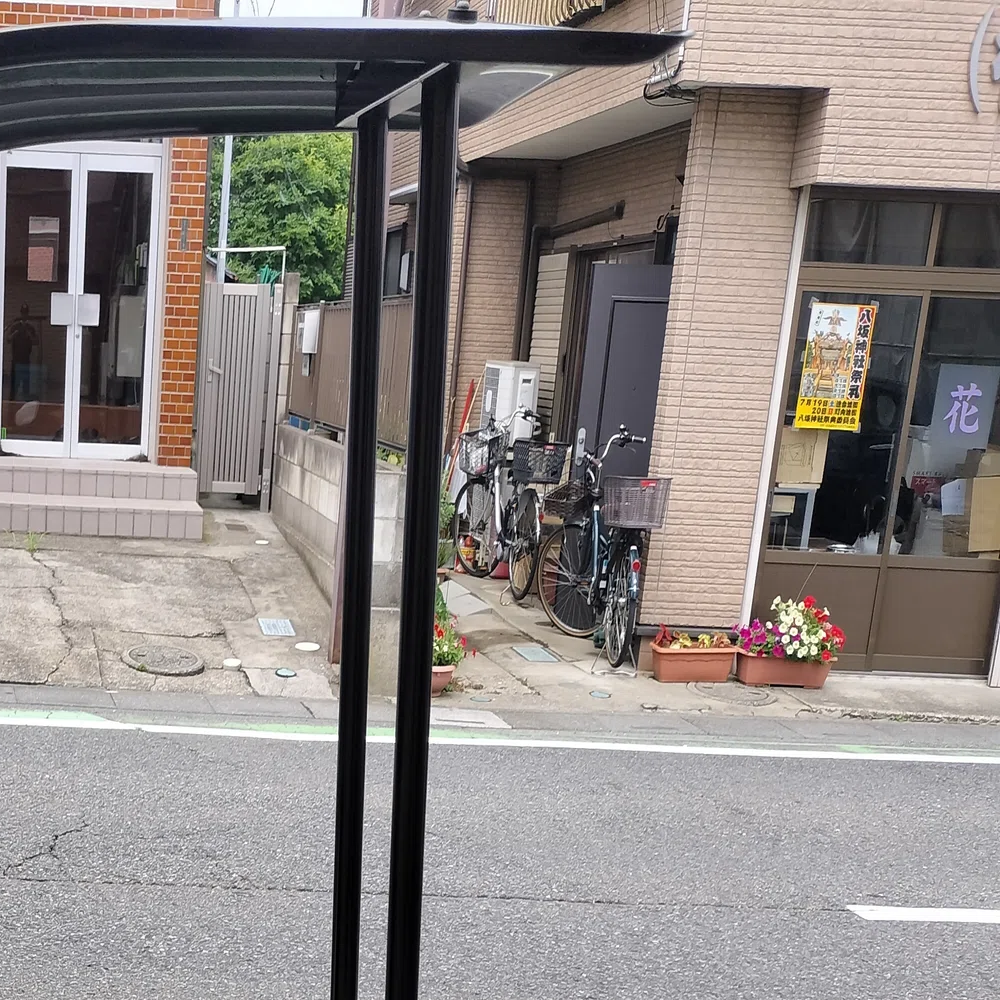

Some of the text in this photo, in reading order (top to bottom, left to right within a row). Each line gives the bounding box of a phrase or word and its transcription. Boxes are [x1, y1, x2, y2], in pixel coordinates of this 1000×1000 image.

[847, 309, 872, 399] 八坂神社祭礼
[943, 383, 982, 433] 花
